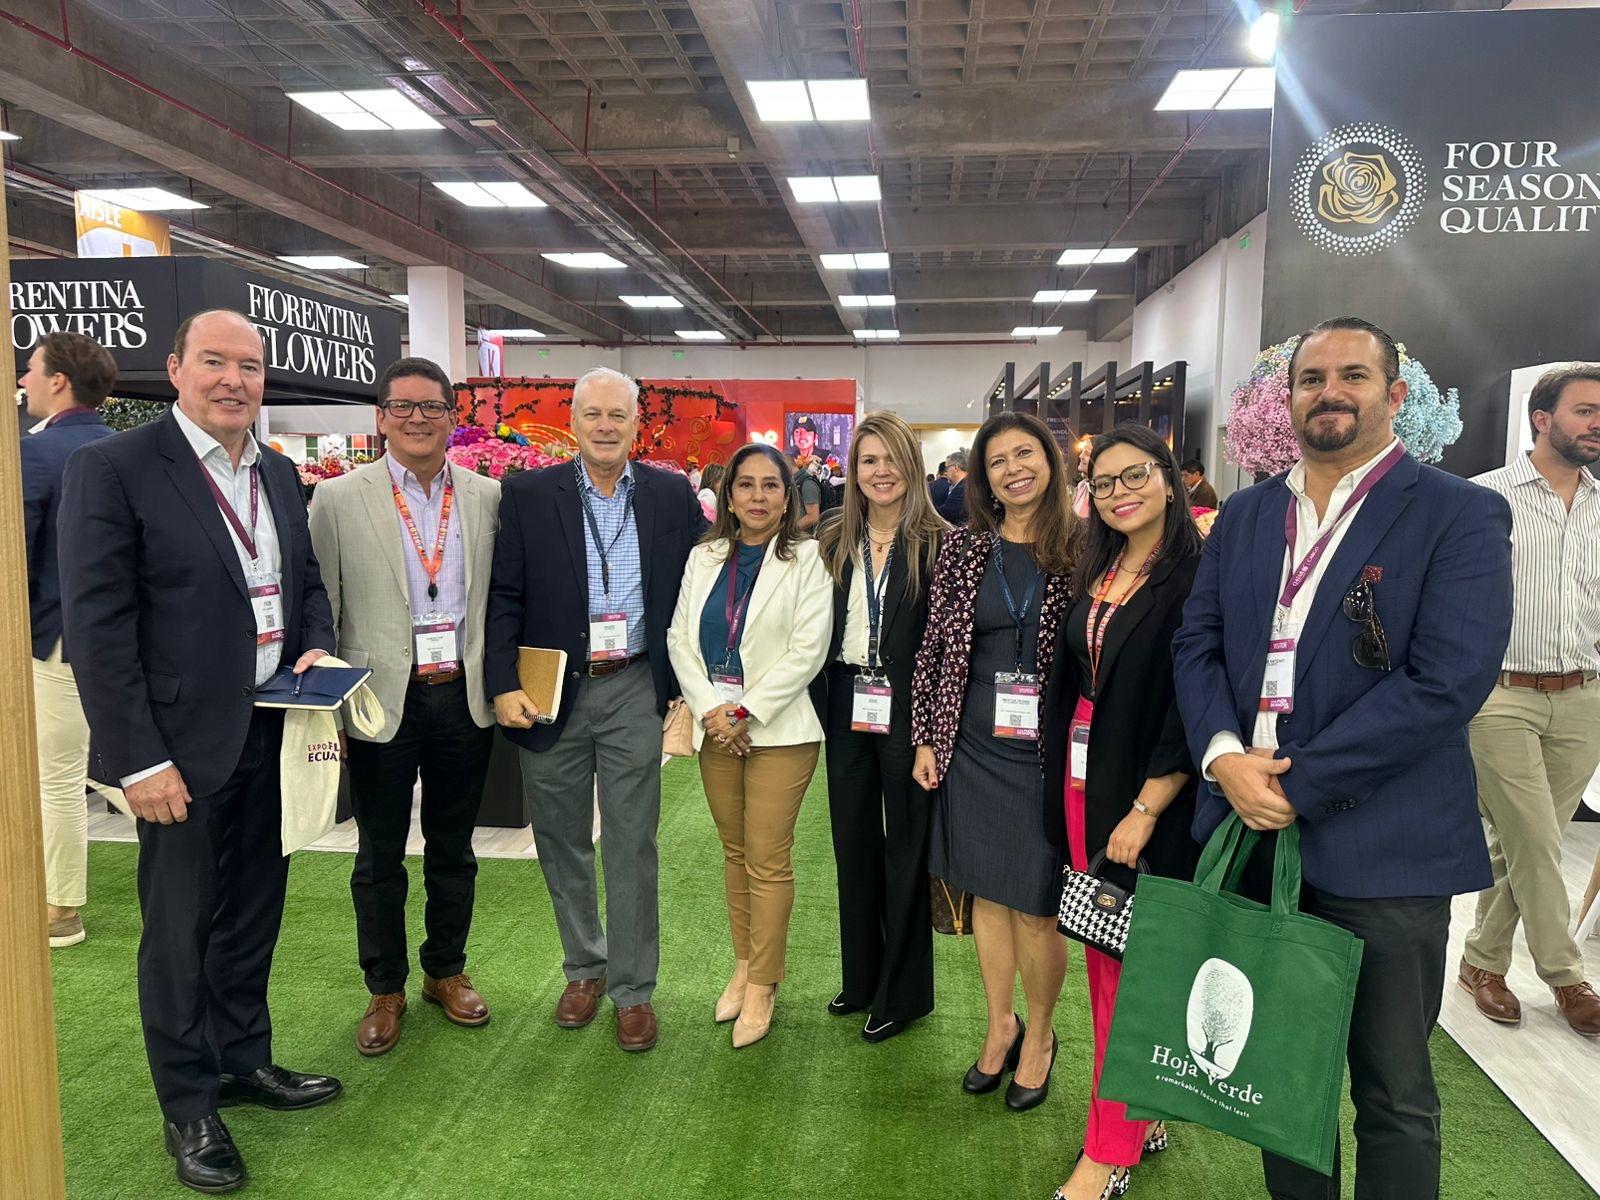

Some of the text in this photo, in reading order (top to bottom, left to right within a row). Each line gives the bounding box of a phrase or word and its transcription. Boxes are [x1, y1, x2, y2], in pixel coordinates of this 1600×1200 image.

[1443, 141, 1561, 170] FOUR
[1440, 205, 1600, 234] QUALIT
[247, 283, 374, 345] FIORENTINA
[1150, 1044, 1263, 1105] Hoja Verde
